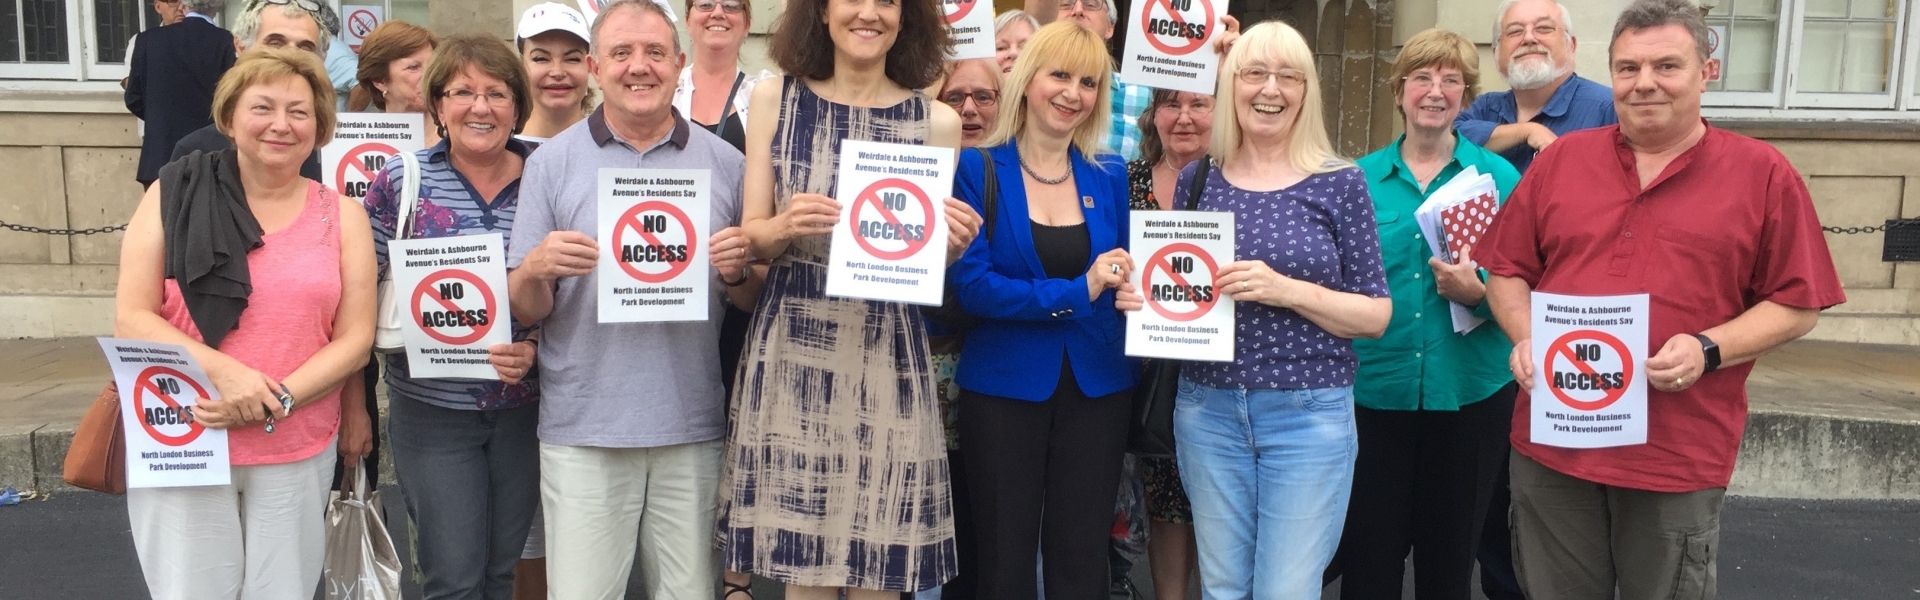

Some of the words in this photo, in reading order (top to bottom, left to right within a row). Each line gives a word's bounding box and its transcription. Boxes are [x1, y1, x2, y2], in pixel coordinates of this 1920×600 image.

[1171, 0, 1191, 11] NO
[1148, 18, 1205, 40] ACCESS
[1137, 55, 1153, 63] North
[1155, 57, 1176, 65] London
[1177, 59, 1205, 69] Business
[1157, 68, 1197, 78] Development
[365, 155, 385, 171] NO
[859, 151, 891, 161] Weirdale
[899, 155, 937, 165] Ashbourne
[855, 164, 887, 173] Avenue's
[889, 166, 924, 176] Residents
[926, 169, 939, 177] Say
[684, 190, 696, 198] Say
[883, 192, 906, 211] NO
[644, 215, 666, 233] NO
[858, 221, 925, 241] ACCESS
[406, 247, 440, 256] Weirdale
[448, 245, 487, 253] Ashbourne
[621, 245, 687, 262] ACCESS
[406, 259, 438, 267] Avenue's
[846, 261, 865, 269] North
[868, 263, 893, 271] London
[895, 266, 928, 274] Business
[1172, 257, 1193, 274] NO
[854, 273, 869, 281] Park
[871, 275, 918, 285] Development
[440, 283, 464, 300] NO
[1150, 284, 1213, 302] ACCESS
[639, 298, 685, 306] Development
[1547, 304, 1579, 313] Weirdale
[1588, 306, 1631, 314] Ashbourne
[423, 309, 488, 327] ACCESS
[1545, 315, 1576, 325] Avenue's
[1162, 324, 1185, 332] London
[1187, 326, 1218, 334] Business
[1166, 336, 1210, 344] Development
[1576, 344, 1601, 362] NO
[156, 378, 180, 395] NO
[1553, 372, 1624, 390] ACCESS
[145, 406, 195, 425] ACCES
[1546, 411, 1565, 420] North
[1554, 424, 1570, 432] Park
[1572, 425, 1622, 433] Development
[142, 451, 158, 459] North
[150, 463, 163, 471] Park
[165, 462, 206, 470] Development
